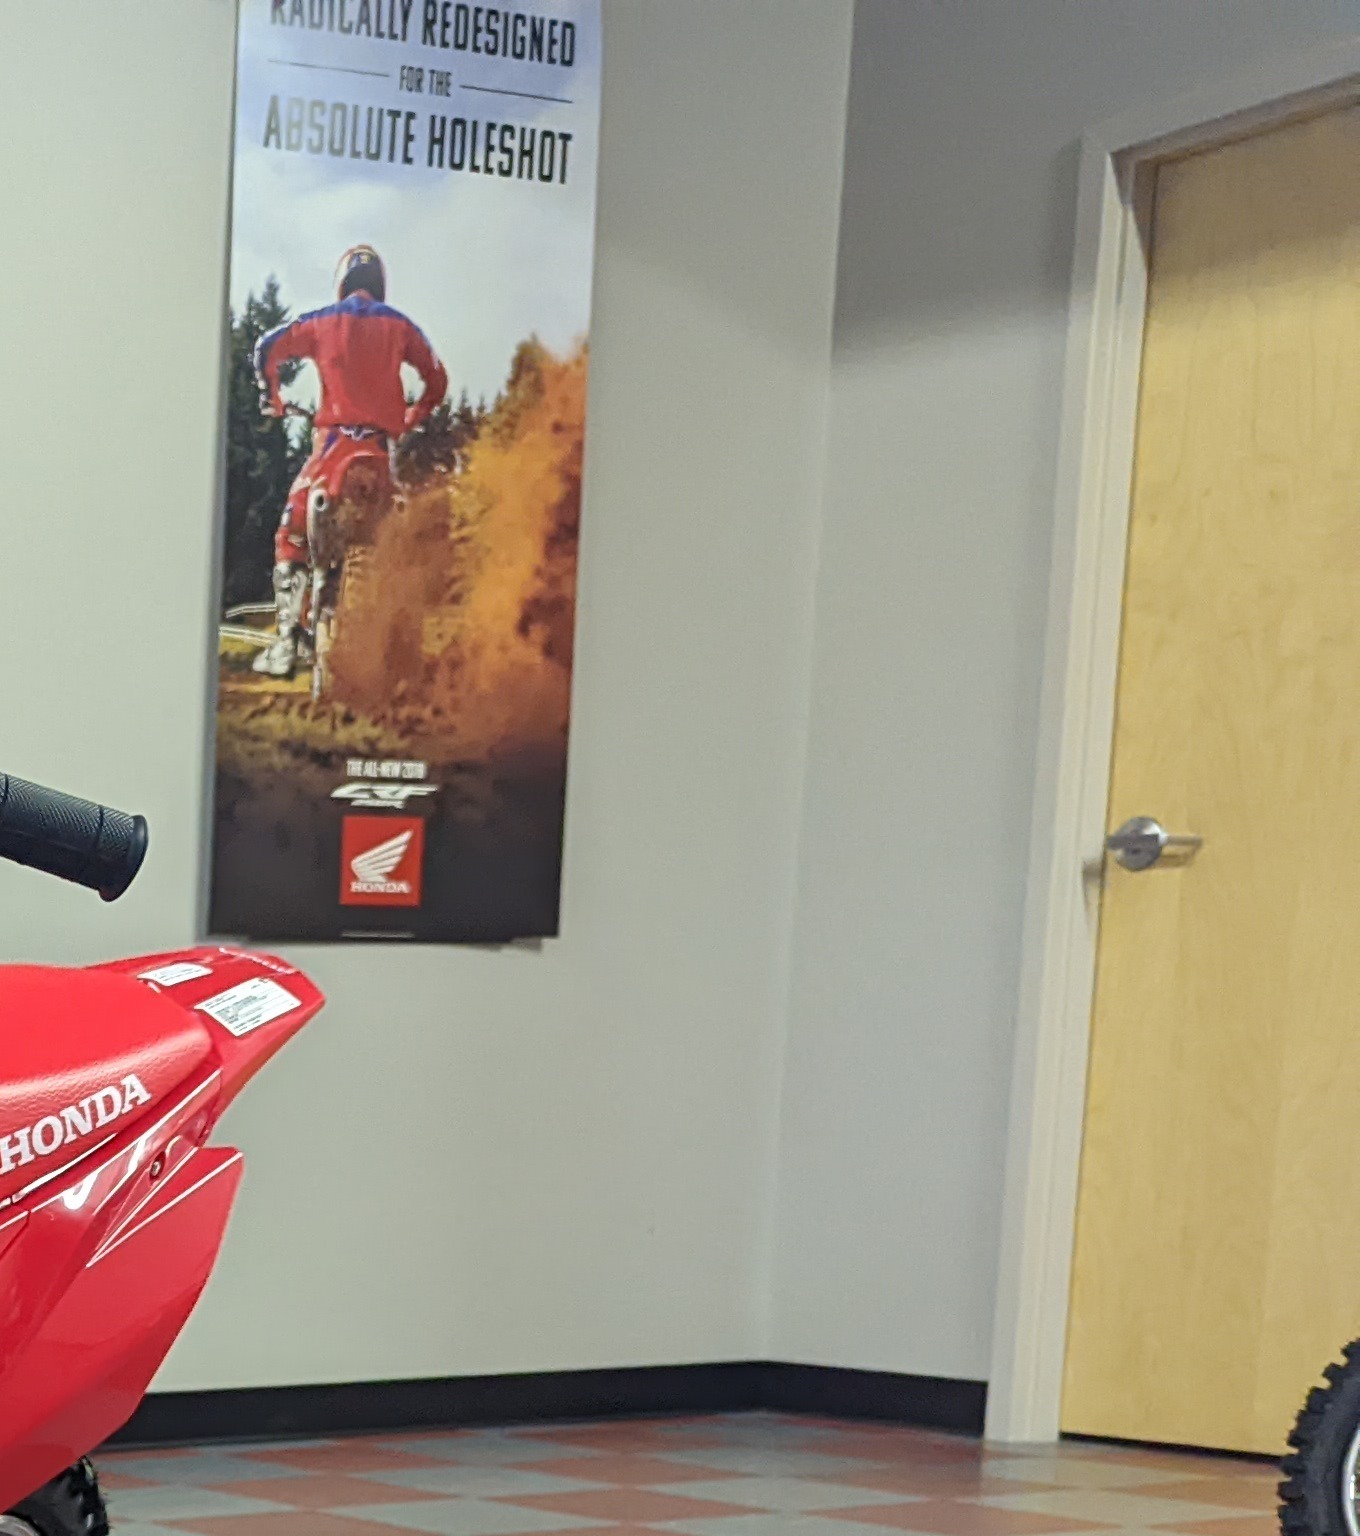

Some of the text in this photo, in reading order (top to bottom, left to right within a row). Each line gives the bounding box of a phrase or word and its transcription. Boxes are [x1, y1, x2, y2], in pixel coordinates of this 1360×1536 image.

[269, 0, 577, 67] RADICALLY REDESIGNED
[399, 64, 452, 97] FOR THE
[262, 95, 573, 185] ABSOLUTE HOLESHOT
[349, 880, 412, 894] HONDA
